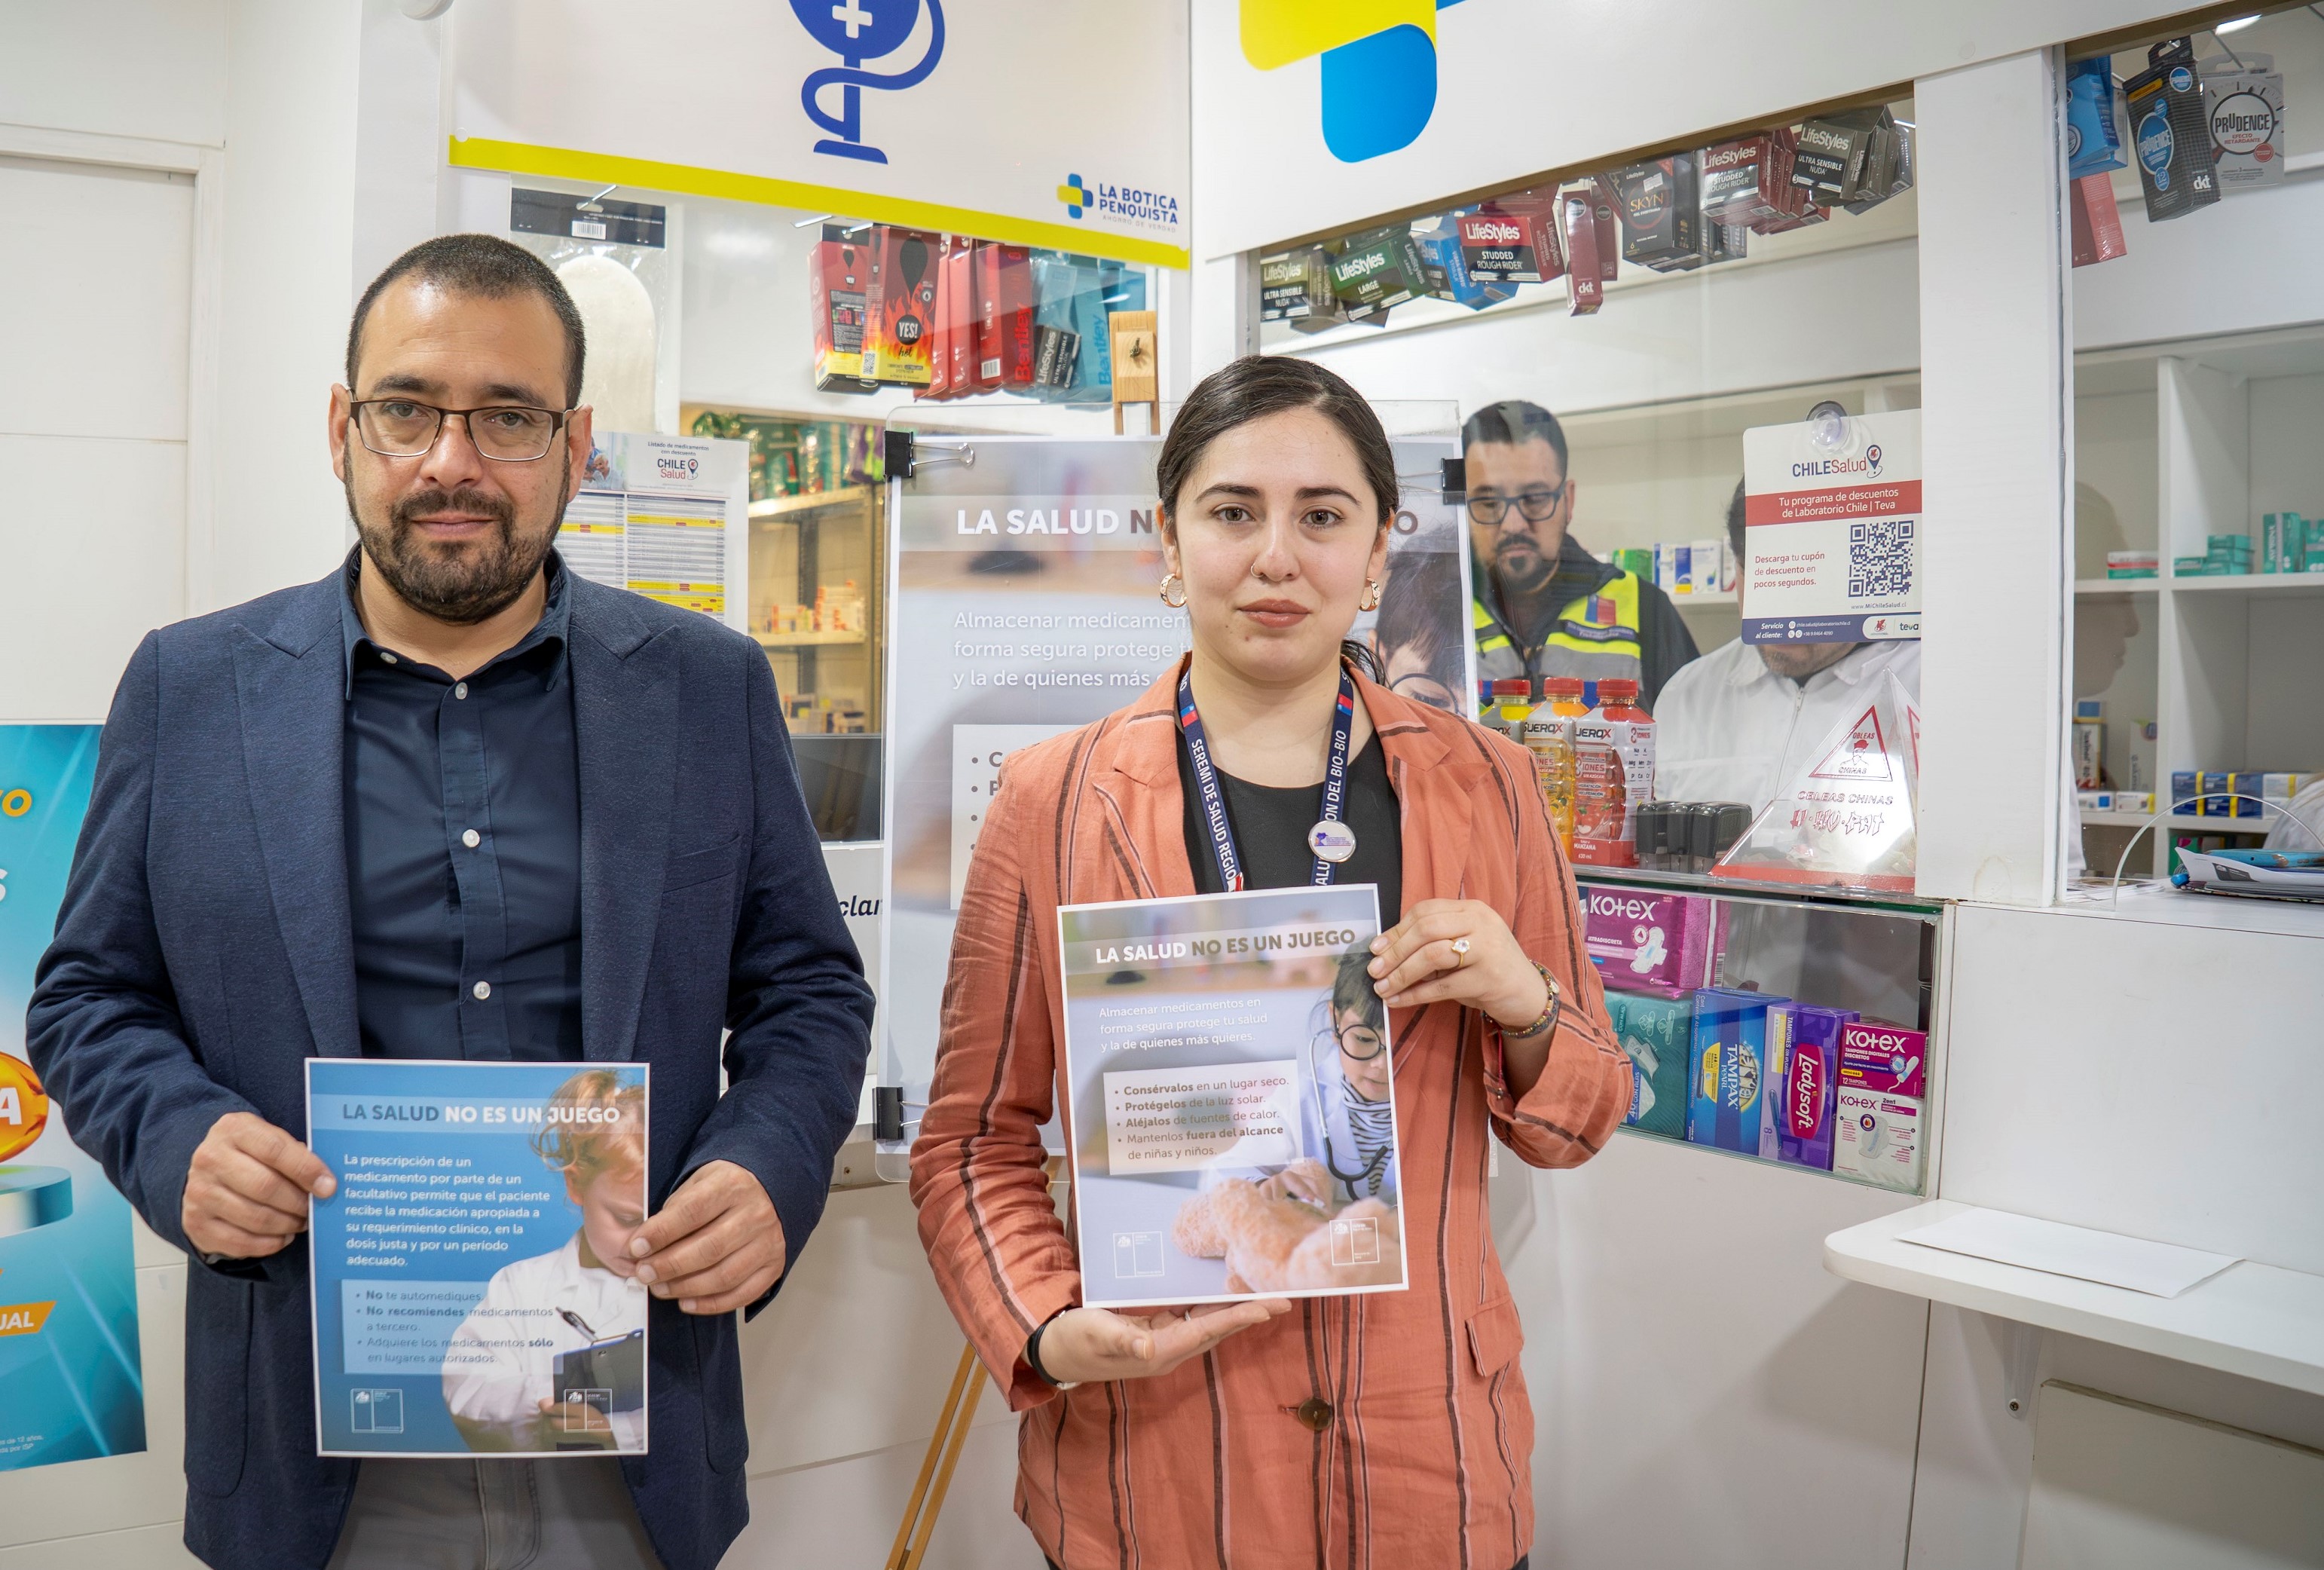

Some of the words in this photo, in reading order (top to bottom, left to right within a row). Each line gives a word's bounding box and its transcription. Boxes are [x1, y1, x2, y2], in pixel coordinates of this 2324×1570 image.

[2215, 112, 2270, 133] PRUDENCE
[1800, 127, 1849, 150] LifeStyles
[2225, 136, 2261, 145] RETARDANTE
[1702, 146, 1757, 170] LifeStyles
[1798, 155, 1816, 165] ULTRA
[1816, 159, 1842, 171] SENSIBLE
[1099, 183, 1118, 198] LA
[1122, 188, 1178, 211] BOTICA
[1630, 193, 1663, 212] SKYN
[1099, 199, 1178, 225] PENQUISTA
[1466, 223, 1520, 243] LifeStyles
[1482, 250, 1513, 260] STUDDED
[1264, 263, 1302, 281] LifeStyles
[1335, 252, 1385, 282] LifeStyles
[1477, 260, 1506, 270] ROUGH
[1506, 261, 1523, 270] RIDER
[1264, 290, 1279, 300] ULTRA
[1280, 286, 1302, 297] SENSIBLE
[1358, 280, 1379, 294] LARGE
[898, 323, 918, 339] YES!
[1015, 302, 1034, 381] Bentley
[657, 458, 686, 470] CHILE
[661, 469, 686, 479] Salud
[1778, 497, 1790, 507] Tu
[1791, 494, 1833, 507] programa
[1835, 492, 1847, 501] de
[1848, 489, 1899, 500] descuentos
[1781, 508, 1793, 518] de
[1795, 505, 1844, 517] Laboratorio
[1845, 503, 1868, 513] Chile
[1874, 501, 1895, 510] Teva
[957, 509, 998, 534] LA
[1006, 509, 1119, 534] SALUD
[1131, 510, 1151, 534] N
[1755, 555, 1790, 564] Descarga
[1801, 552, 1824, 562] cupón
[1754, 568, 1764, 576] de
[1765, 566, 1805, 575] descuento
[1754, 581, 1776, 590] pocos
[1778, 577, 1816, 589] segundos.
[954, 611, 1062, 629] Almacenar
[1068, 611, 1186, 629] medicamen
[1761, 622, 1784, 630] Servicio
[1900, 621, 1919, 631] teva
[954, 639, 1013, 657] forma
[1020, 643, 1087, 661] segura
[1094, 640, 1173, 661] protege
[953, 673, 965, 690] y
[971, 669, 987, 686] la
[993, 669, 1018, 686] de
[1023, 668, 1103, 691] quienes
[1109, 669, 1150, 687] más
[1191, 738, 1212, 782] SEREMI
[1331, 730, 1347, 777] BIO-BIO
[1203, 784, 1217, 802] DE
[1327, 779, 1341, 802] DEL
[1208, 801, 1226, 842] SALUD
[1218, 841, 1237, 880] REGIO
[1096, 947, 1120, 964] LA
[1123, 941, 1186, 961] SALUD
[1191, 939, 1222, 956] NO
[1226, 937, 1249, 953] ES
[1253, 934, 1282, 950] UN
[1287, 929, 1356, 948] JUEGO
[1099, 1005, 1157, 1018] Almacenar
[1161, 999, 1244, 1013] medicamentos
[1246, 999, 1261, 1007] en
[1100, 1024, 1133, 1034] forma
[1136, 1022, 1173, 1033] segura
[1176, 1018, 1220, 1032] protege
[1223, 1015, 1236, 1025] tu
[1237, 1012, 1267, 1024] salud
[1100, 1042, 1108, 1053] y
[1111, 1040, 1121, 1050] la
[1123, 1039, 1136, 1049] de
[1139, 1036, 1183, 1050] quienes
[1185, 1034, 1209, 1045] más
[1212, 1031, 1255, 1045] quieres.
[1727, 1043, 1738, 1107] TAMPAX
[1124, 1082, 1194, 1095] Consérvalos
[1212, 1082, 1227, 1090] un
[1230, 1079, 1258, 1090] lugar
[1260, 1077, 1289, 1087] seco.
[1795, 1052, 1818, 1129] Ladysoft
[1125, 1099, 1186, 1112] Protégelos
[1189, 1097, 1203, 1108] de
[1206, 1096, 1215, 1107] la
[1218, 1095, 1234, 1106] luz
[1237, 1094, 1265, 1104] solar.
[343, 1103, 367, 1119] LA
[372, 1104, 439, 1122] SALUD
[445, 1106, 478, 1123] NO
[482, 1106, 506, 1123] ES
[512, 1106, 542, 1124] UN
[547, 1106, 621, 1124] JUEGO
[1125, 1116, 1170, 1129] Aléjalos
[1173, 1115, 1187, 1125] de
[1189, 1112, 1230, 1123] fuentes
[1233, 1110, 1246, 1121] de
[1249, 1109, 1280, 1119] calor.
[1127, 1131, 1183, 1143] Mantenlos
[1185, 1130, 1216, 1140] fuera
[1219, 1127, 1237, 1138] del
[1239, 1127, 1283, 1137] alcance
[344, 1153, 358, 1164] La
[360, 1155, 435, 1168] prescripción
[437, 1156, 453, 1168] de
[455, 1158, 471, 1167] un
[1127, 1150, 1141, 1160] de
[1144, 1148, 1173, 1158] niñas
[1175, 1149, 1182, 1159] y
[1185, 1146, 1217, 1156] niños.
[344, 1171, 427, 1183] medicamento
[430, 1175, 451, 1186] por
[453, 1174, 485, 1186] parte
[487, 1174, 503, 1184] de
[505, 1175, 521, 1185] un
[344, 1187, 408, 1200] facultativo
[410, 1189, 457, 1201] permite
[459, 1192, 482, 1202] que
[484, 1190, 496, 1201] el
[498, 1190, 550, 1203] paciente
[344, 1204, 383, 1217] recibe
[384, 1205, 396, 1217] la
[398, 1206, 468, 1217] medicación
[470, 1207, 530, 1220] apropiada
[532, 1209, 540, 1217] a
